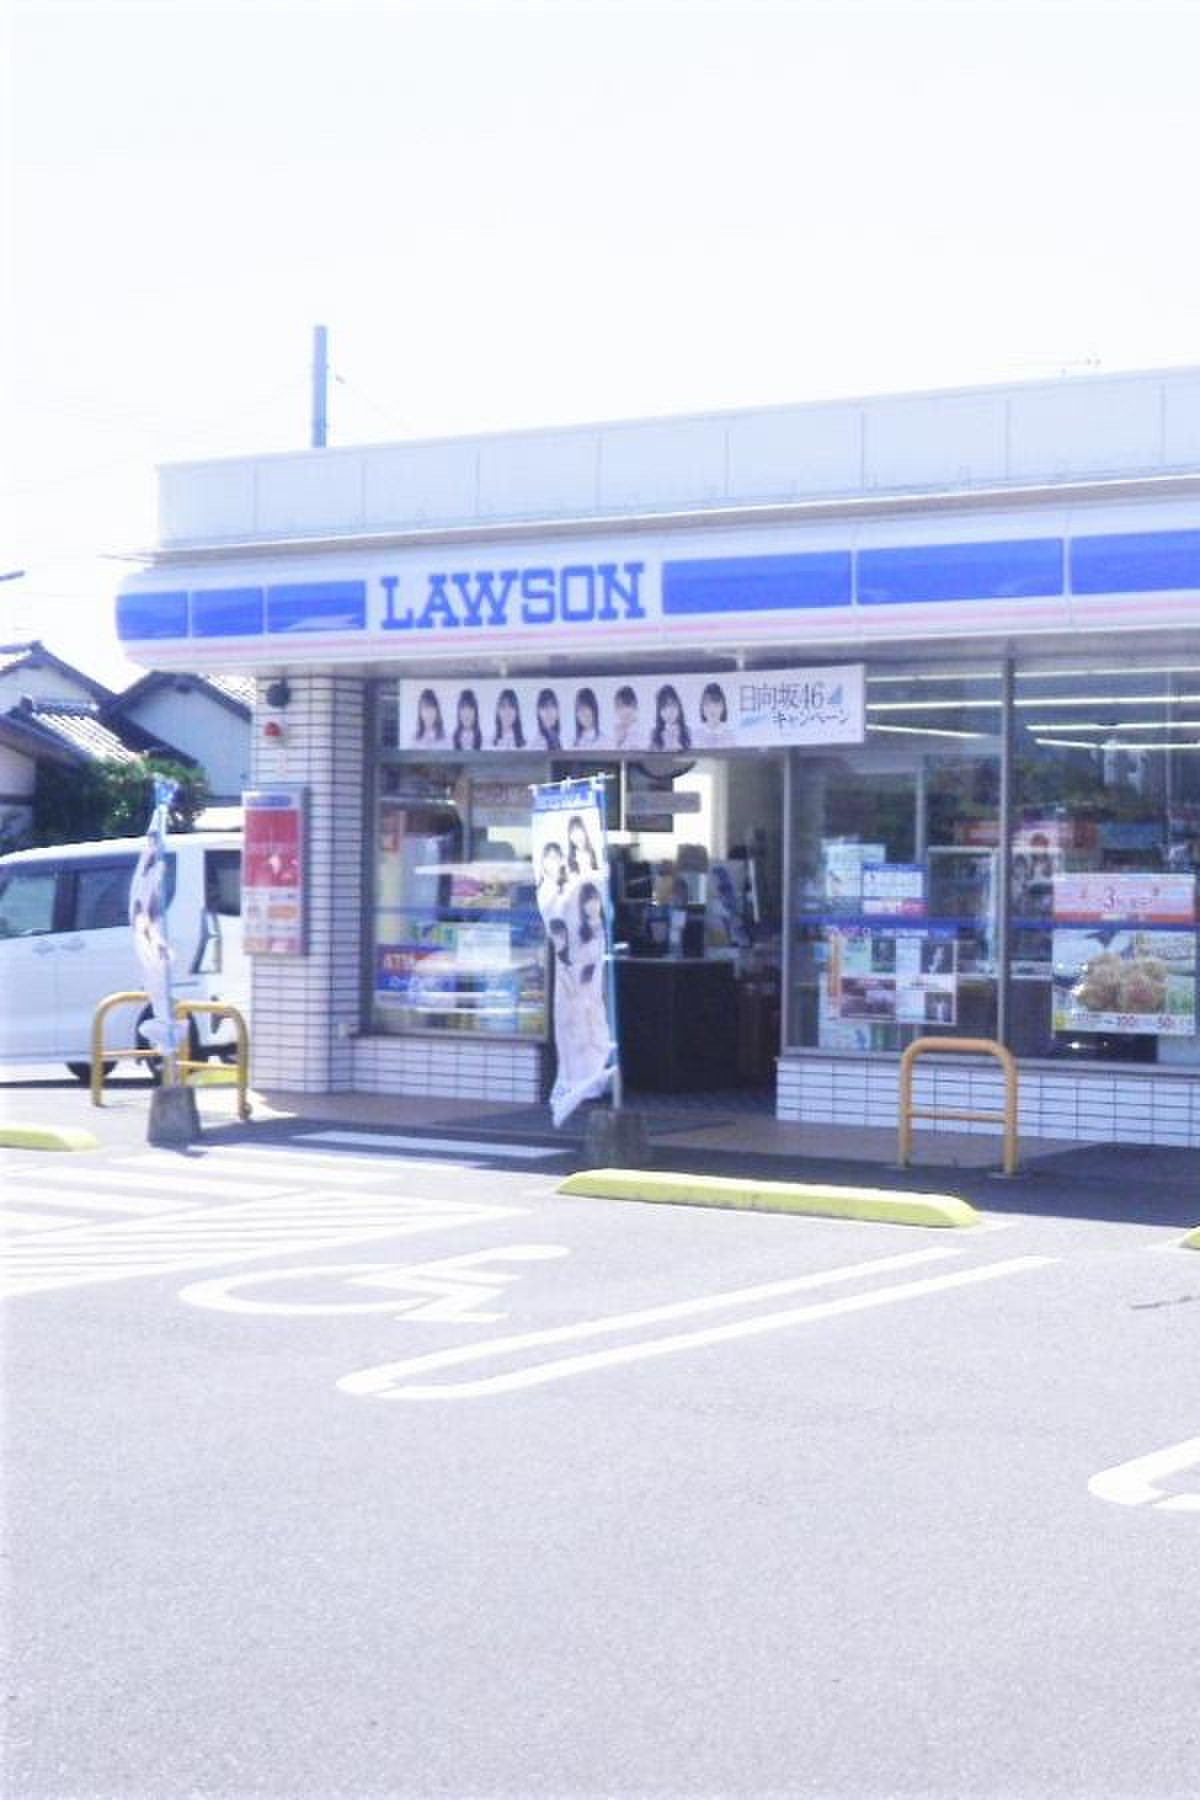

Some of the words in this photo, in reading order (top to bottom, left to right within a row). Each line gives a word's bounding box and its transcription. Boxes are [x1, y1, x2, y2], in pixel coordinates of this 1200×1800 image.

[380, 561, 646, 631] LAWSON
[740, 682, 826, 711] 日向坂46
